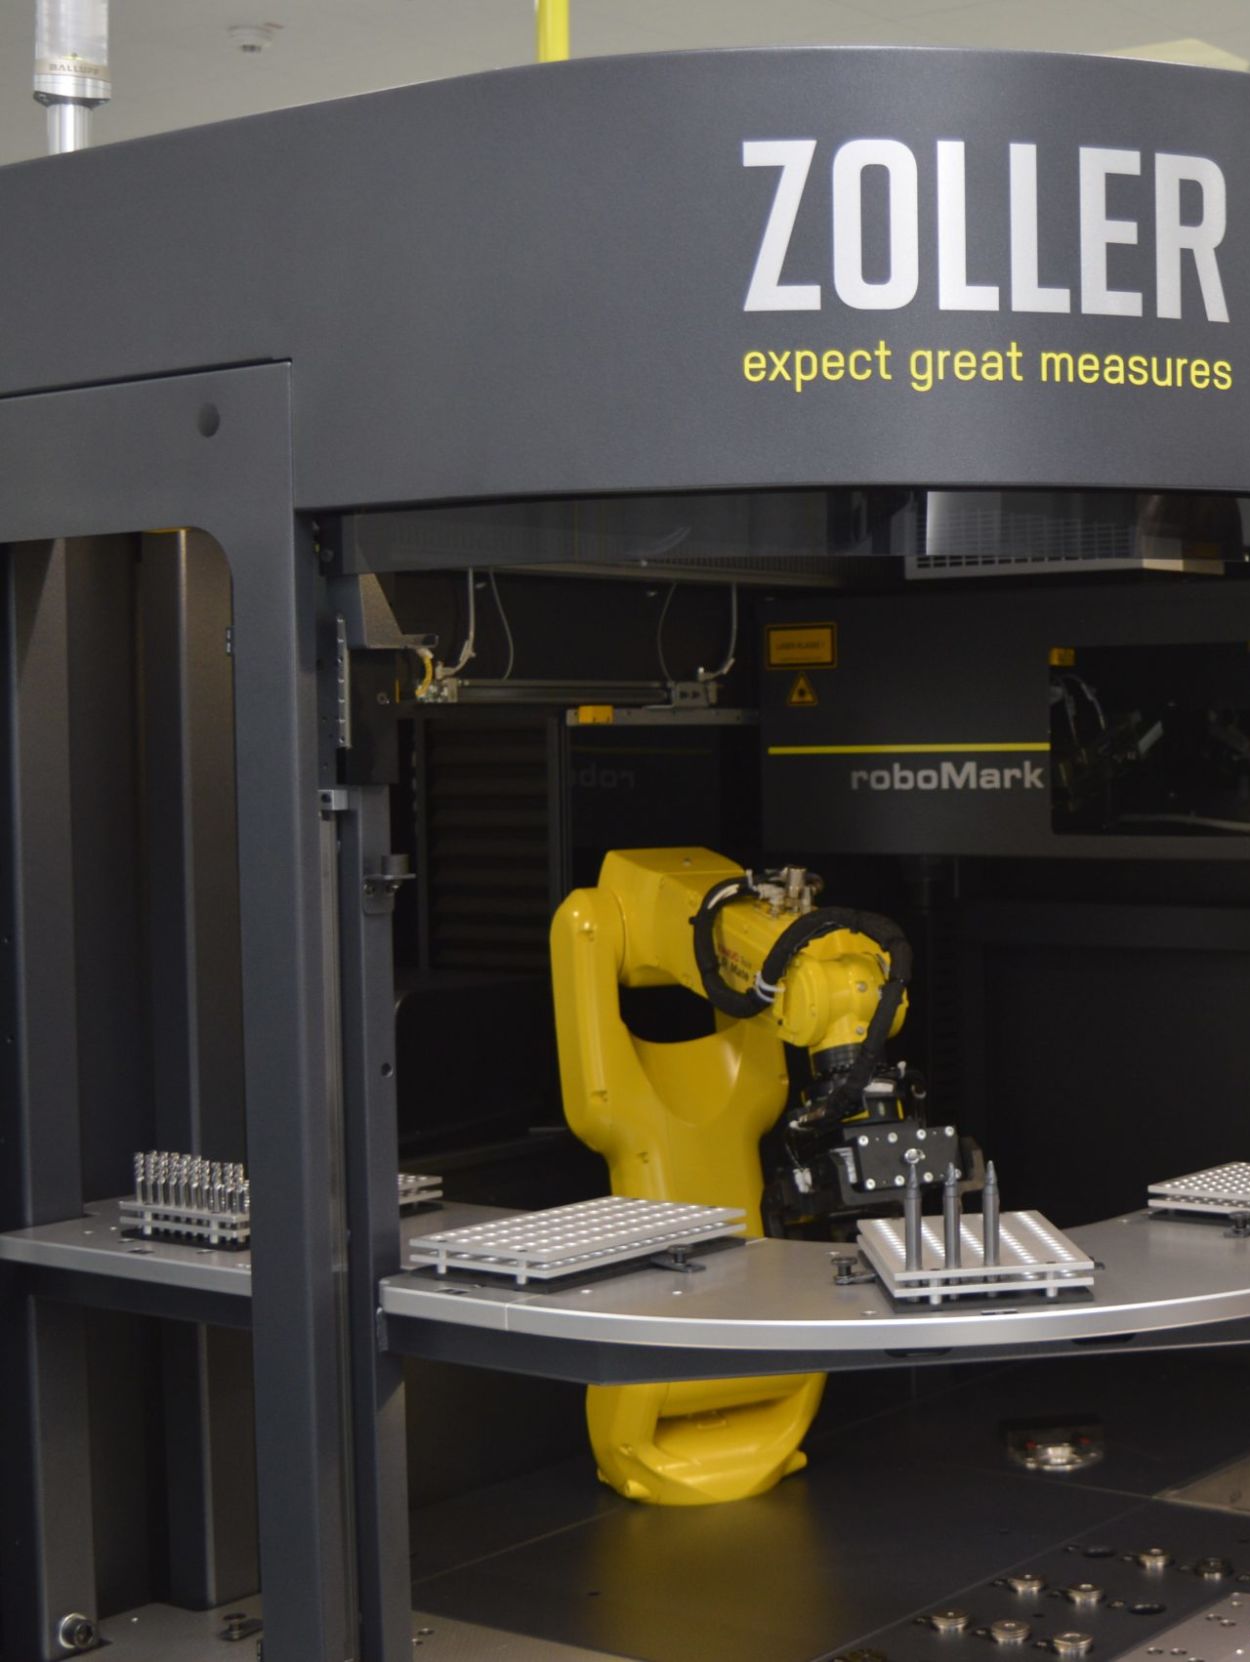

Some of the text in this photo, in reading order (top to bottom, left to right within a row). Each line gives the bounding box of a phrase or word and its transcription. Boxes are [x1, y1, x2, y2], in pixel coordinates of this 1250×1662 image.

[742, 138, 1231, 323] ZOLLER
[743, 341, 1233, 392] expect great measures
[850, 760, 1045, 791] roboMark
